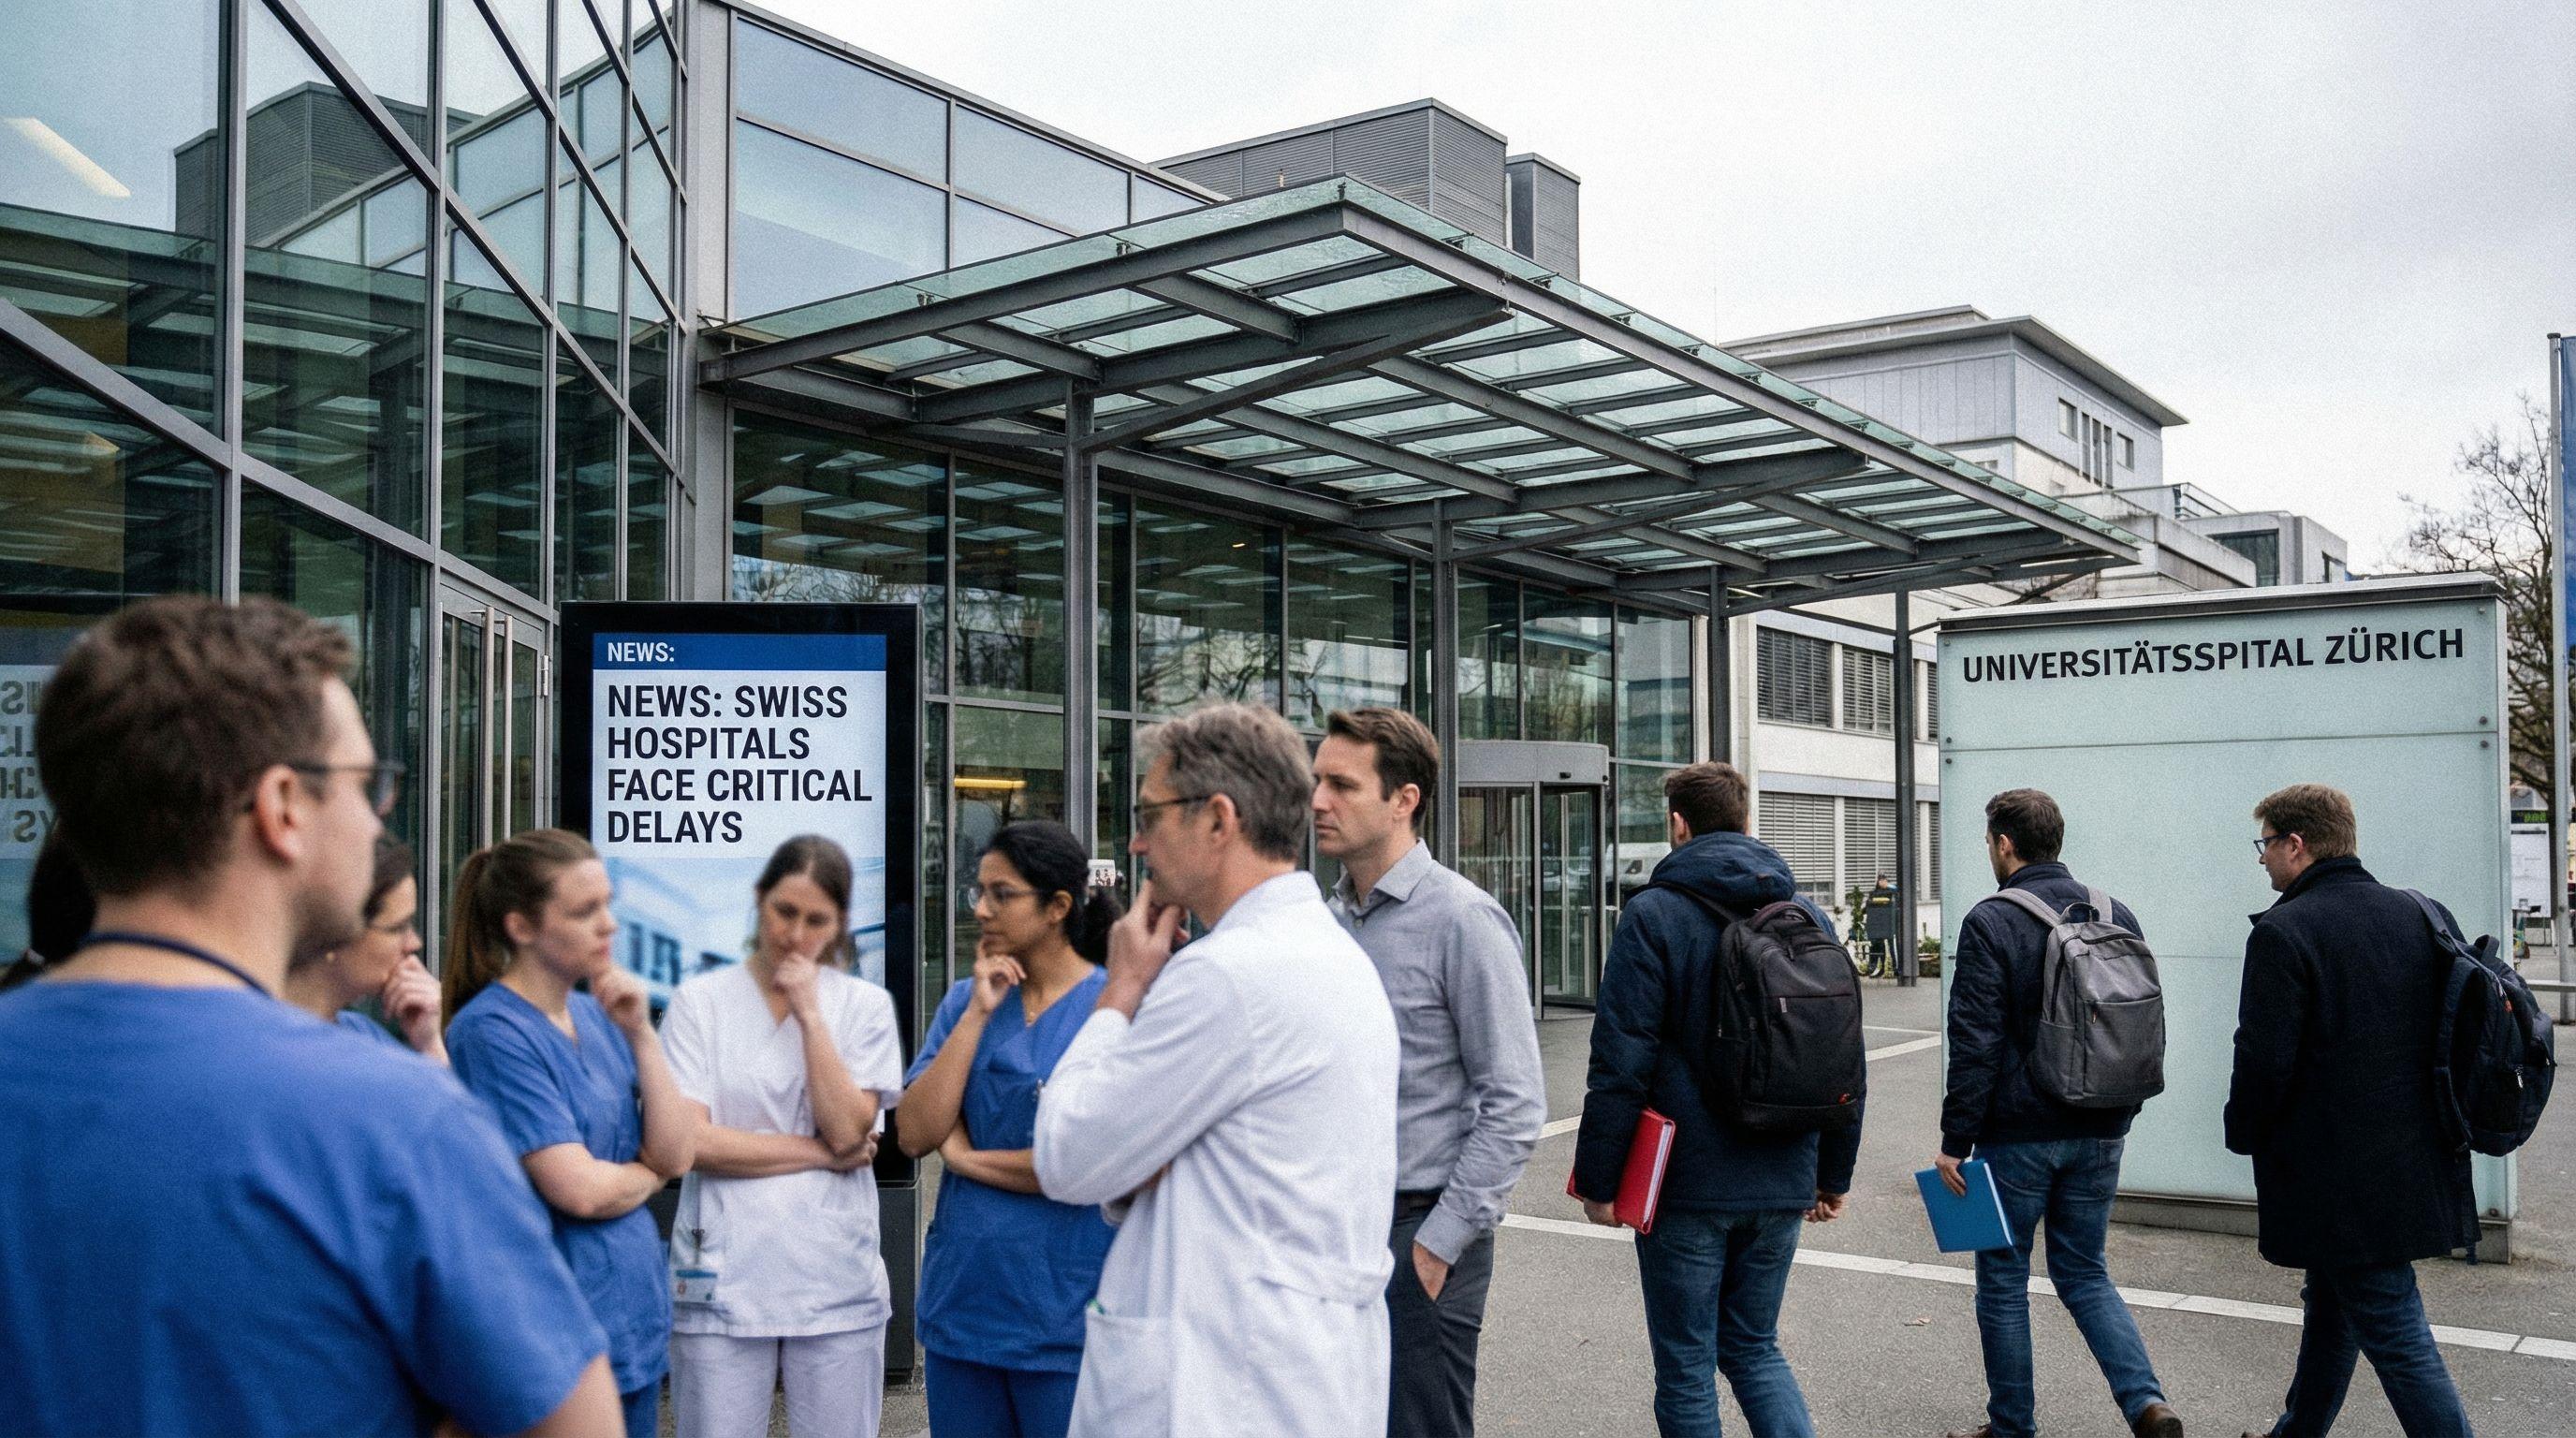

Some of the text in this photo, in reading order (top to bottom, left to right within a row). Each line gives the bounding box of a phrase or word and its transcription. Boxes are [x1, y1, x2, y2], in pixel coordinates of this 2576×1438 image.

[607, 642, 675, 662] NEWS:
[1964, 627, 2464, 682] UNIVERSITÄTSSPITAL ZÜRICH
[607, 685, 847, 718] NEWS: SWISS
[607, 727, 810, 759] HOSPITALS
[607, 769, 872, 801] FACE CRITICAL
[607, 811, 742, 843] DELAYS
